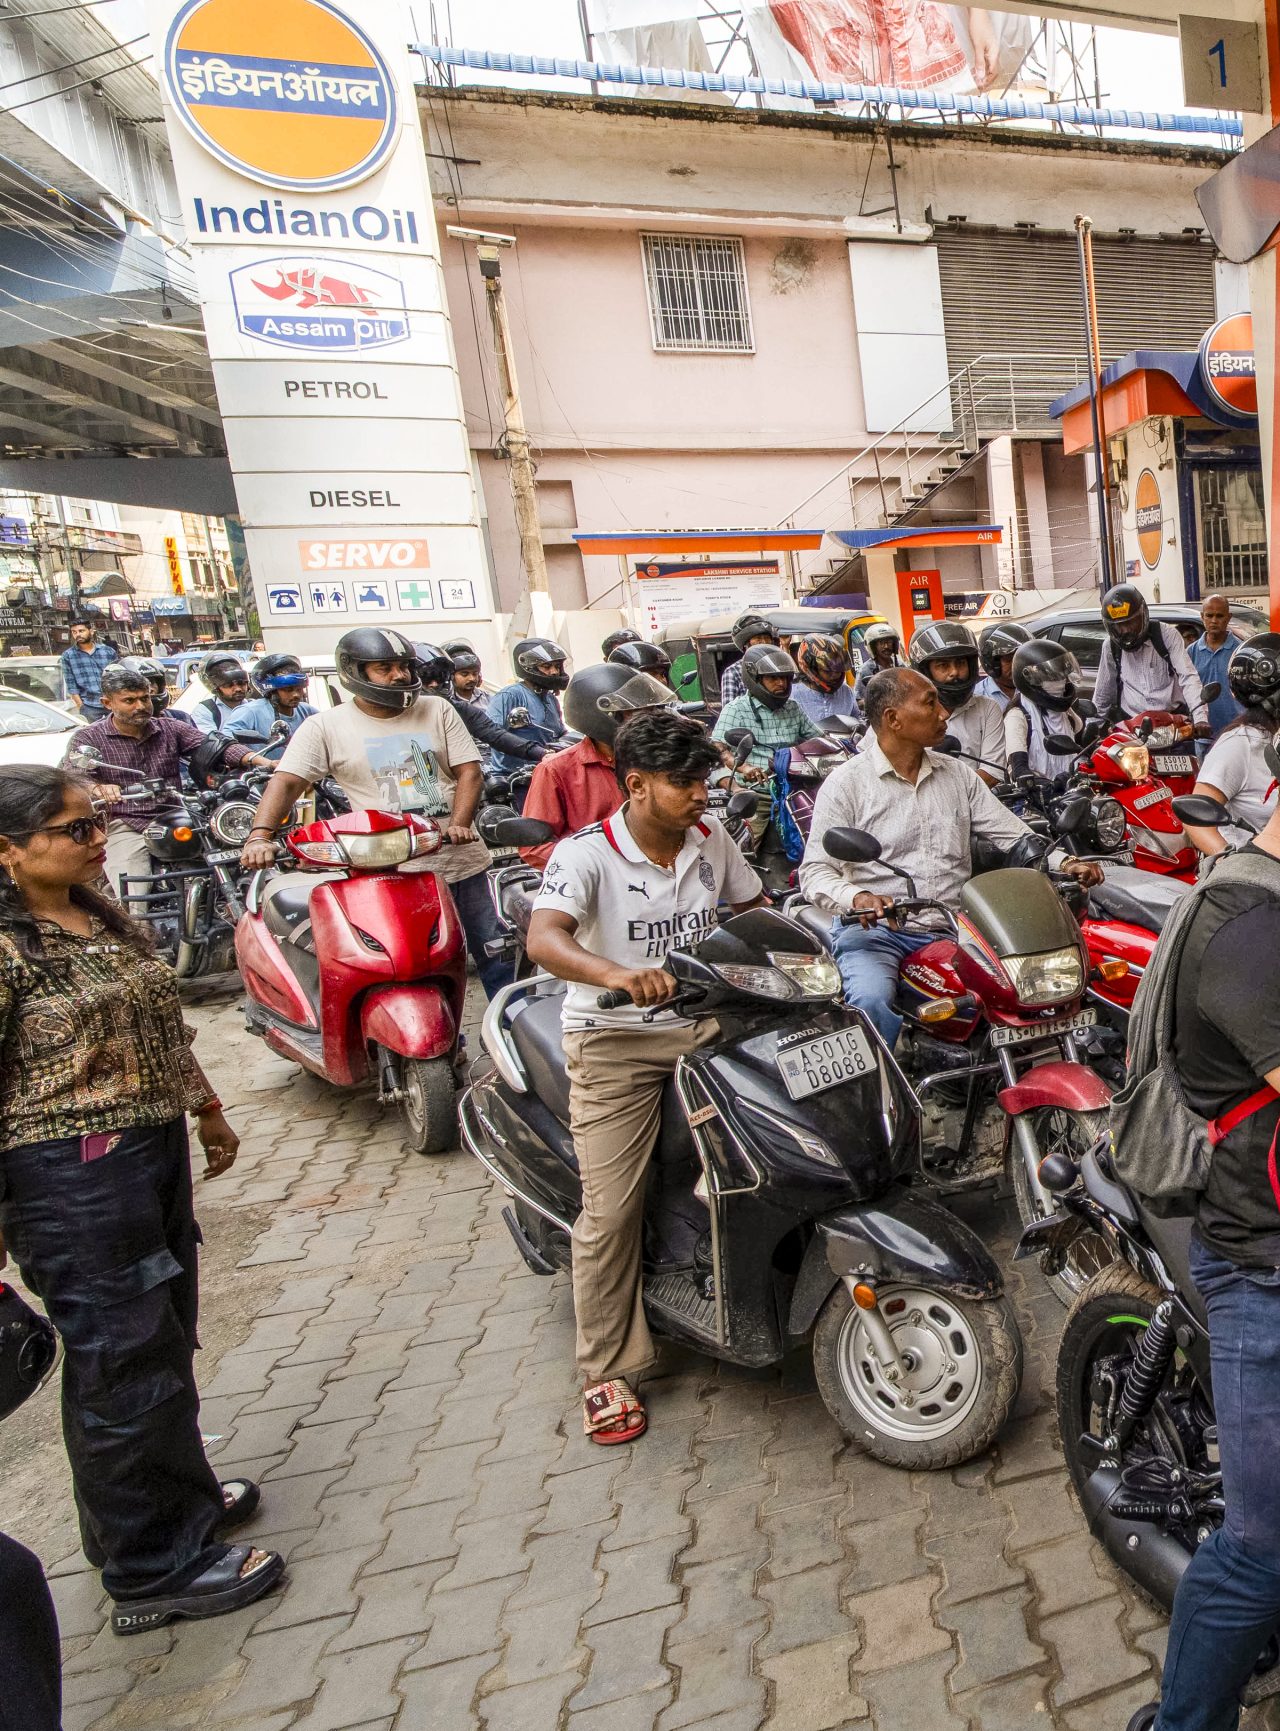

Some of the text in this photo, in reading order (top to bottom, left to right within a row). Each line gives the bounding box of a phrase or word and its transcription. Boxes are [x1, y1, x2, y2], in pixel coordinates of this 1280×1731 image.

[1208, 39, 1229, 88] 1
[180, 56, 379, 106] इंडियनऑयल
[194, 197, 419, 244] IndianOil
[262, 317, 346, 338] Assam
[284, 380, 388, 400] PETROL
[309, 490, 400, 508] DIESEL
[977, 532, 994, 540] AIR
[910, 576, 928, 586] AIR
[964, 602, 978, 610] AIR
[368, 874, 403, 883] HONDA
[646, 938, 669, 958] FLY
[776, 1028, 822, 1047] HONDA
[800, 1033, 858, 1068] AS01G
[807, 1052, 866, 1089] D8088
[116, 1612, 158, 1627] Dior
